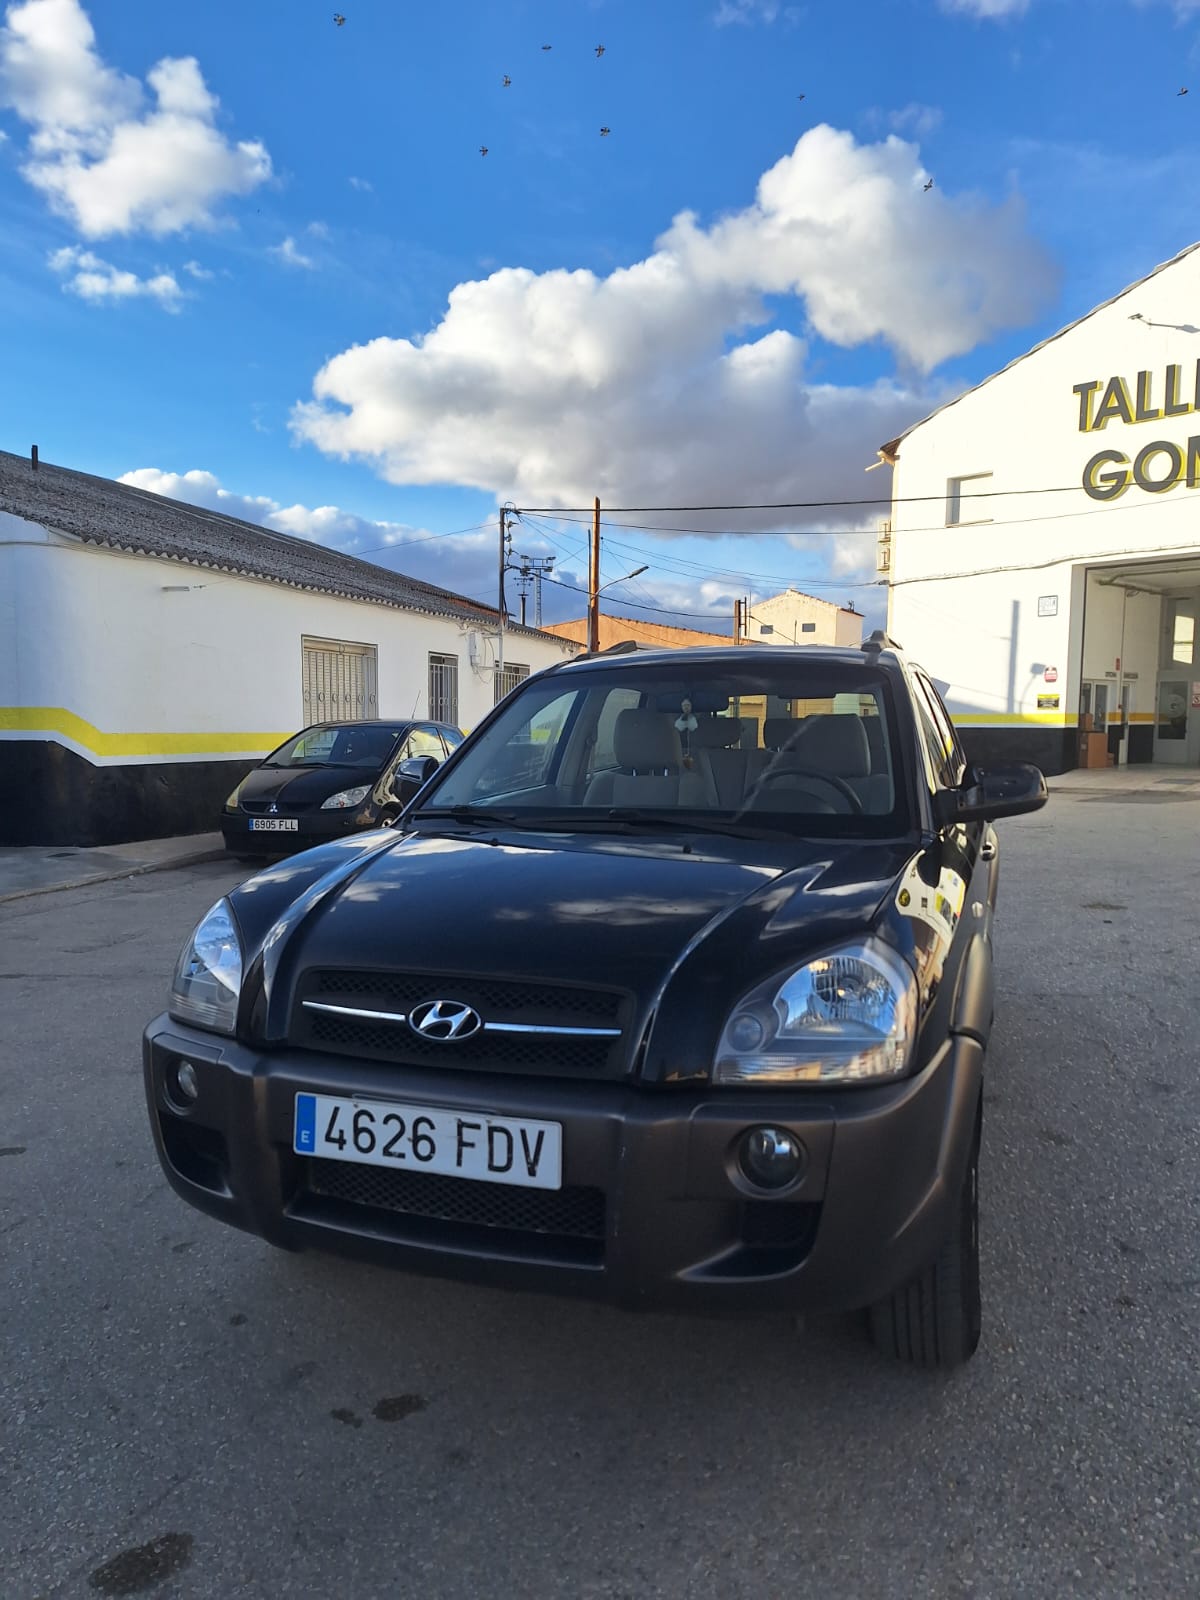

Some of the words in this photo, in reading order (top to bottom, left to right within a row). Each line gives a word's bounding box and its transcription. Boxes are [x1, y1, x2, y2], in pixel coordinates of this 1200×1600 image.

[1072, 358, 1200, 432] TALL
[254, 820, 276, 829] 6905
[279, 820, 296, 830] FLL
[301, 1130, 310, 1143] E
[324, 1106, 436, 1162] 4626
[456, 1118, 545, 1177] FDV
